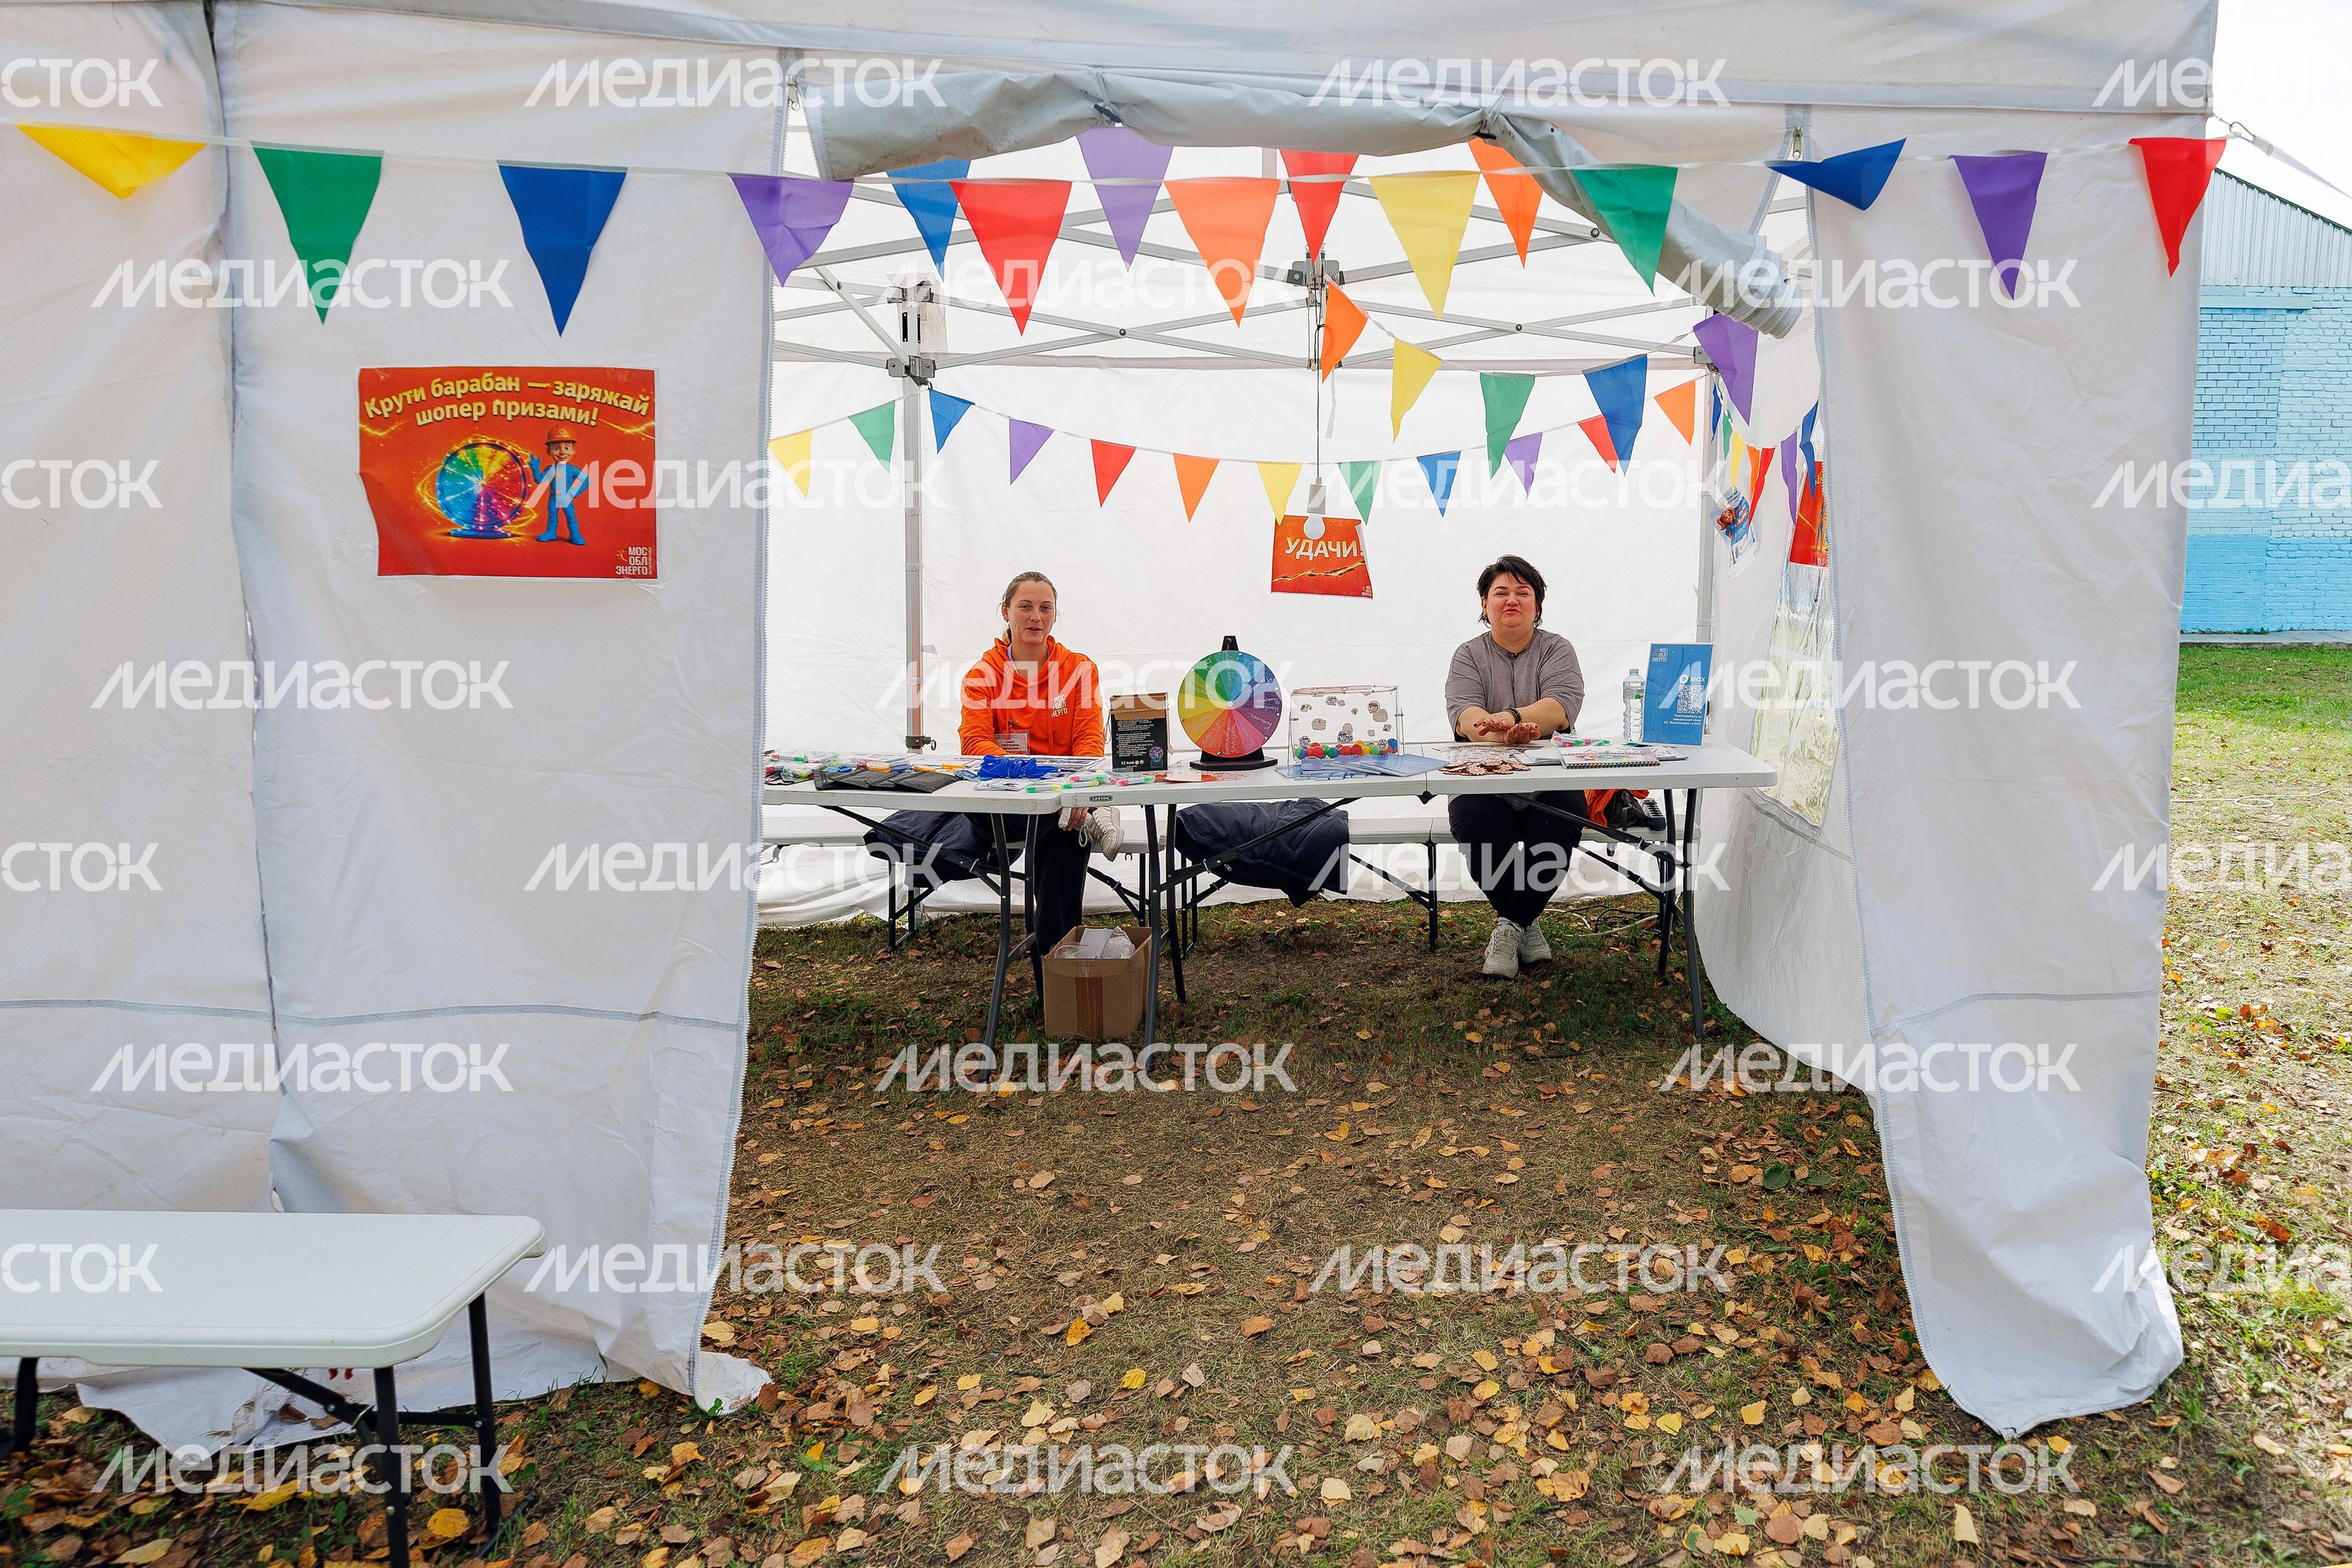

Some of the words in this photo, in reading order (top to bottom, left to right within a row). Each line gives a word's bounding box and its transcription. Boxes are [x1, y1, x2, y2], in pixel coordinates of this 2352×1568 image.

[364, 386, 426, 418] Крути
[430, 372, 520, 399] барабан
[552, 380, 650, 416] заряжай
[415, 401, 486, 426] шопер
[493, 399, 598, 426] призами!
[628, 547, 648, 556] МОС
[629, 556, 648, 566] ОБЛ
[616, 565, 648, 575] ЭНЕРГО
